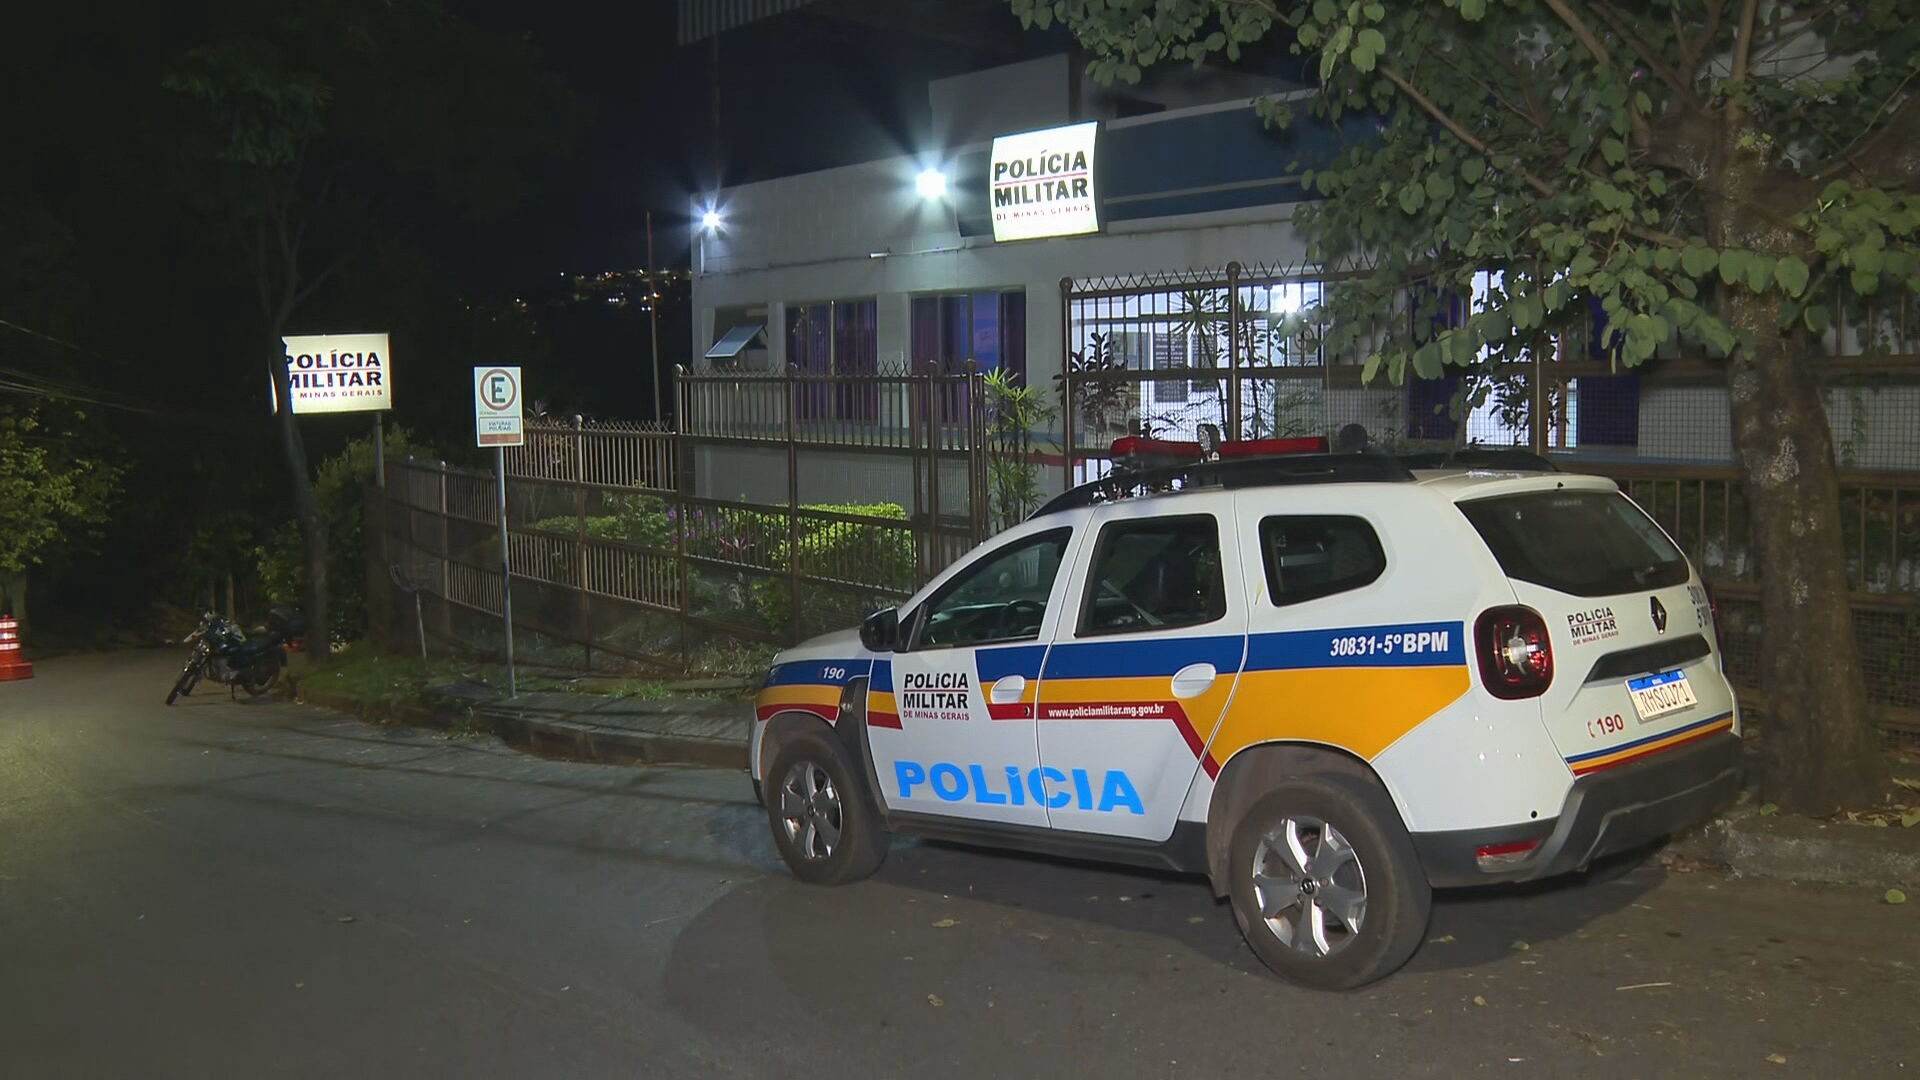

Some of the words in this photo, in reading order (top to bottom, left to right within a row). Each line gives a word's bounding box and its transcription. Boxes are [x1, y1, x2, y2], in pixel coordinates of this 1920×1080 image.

[994, 149, 1088, 182] POLÍCIA
[994, 178, 1089, 208] MILITAR
[300, 391, 336, 399] MINAS
[341, 389, 383, 397] GERAIS
[491, 376, 506, 403] E
[1570, 619, 1617, 639] MILITAR
[1582, 634, 1600, 643] MINAS
[823, 666, 846, 680] 190
[903, 693, 969, 709] MILITAR
[903, 710, 913, 718] DE
[915, 711, 939, 720] MINAS
[940, 712, 970, 721] GERAIS
[1048, 704, 1165, 719] www.policiamilitar.mg.gov.br
[1596, 713, 1624, 736] 190
